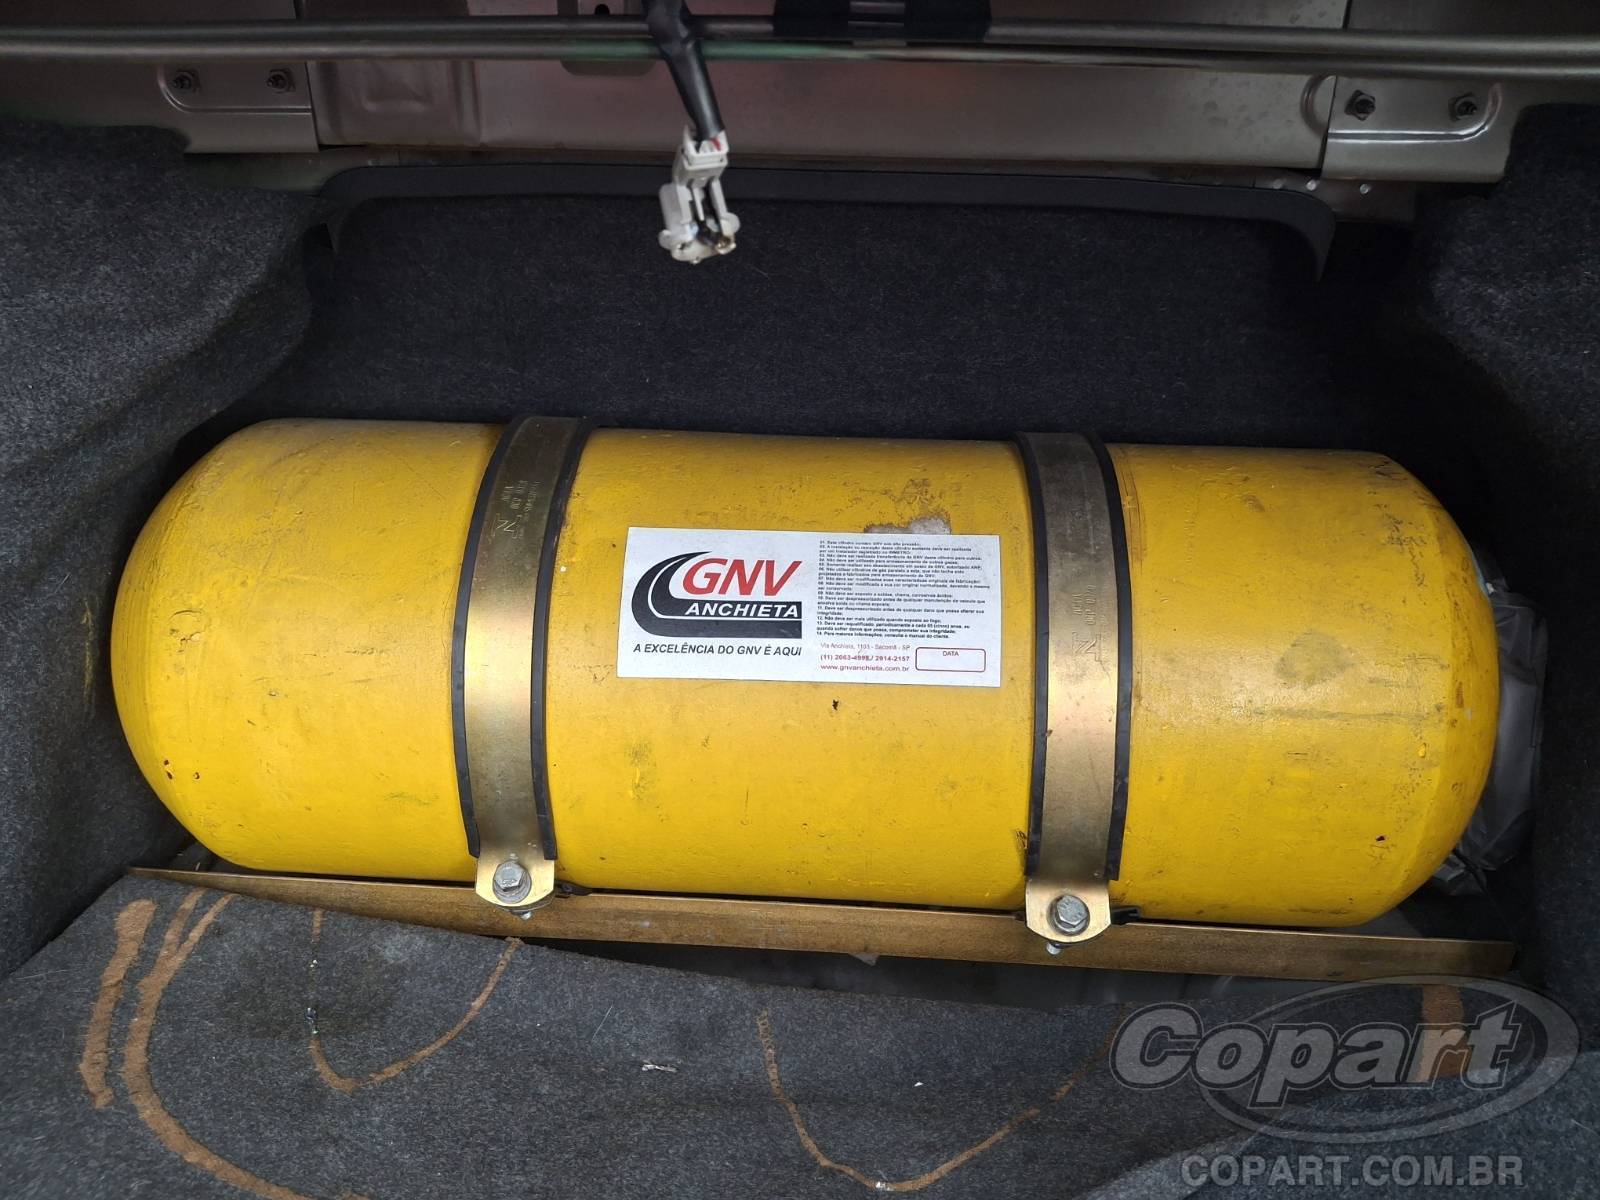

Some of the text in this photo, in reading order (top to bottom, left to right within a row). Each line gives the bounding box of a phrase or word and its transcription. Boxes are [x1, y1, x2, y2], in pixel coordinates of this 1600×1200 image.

[682, 558, 802, 596] GNV
[685, 602, 798, 618] ANCHIETA
[633, 644, 641, 652] A
[644, 642, 714, 654] EXCELÊNCIA
[718, 645, 734, 654] DO
[737, 646, 762, 654] GNV
[773, 646, 802, 656] AQUI
